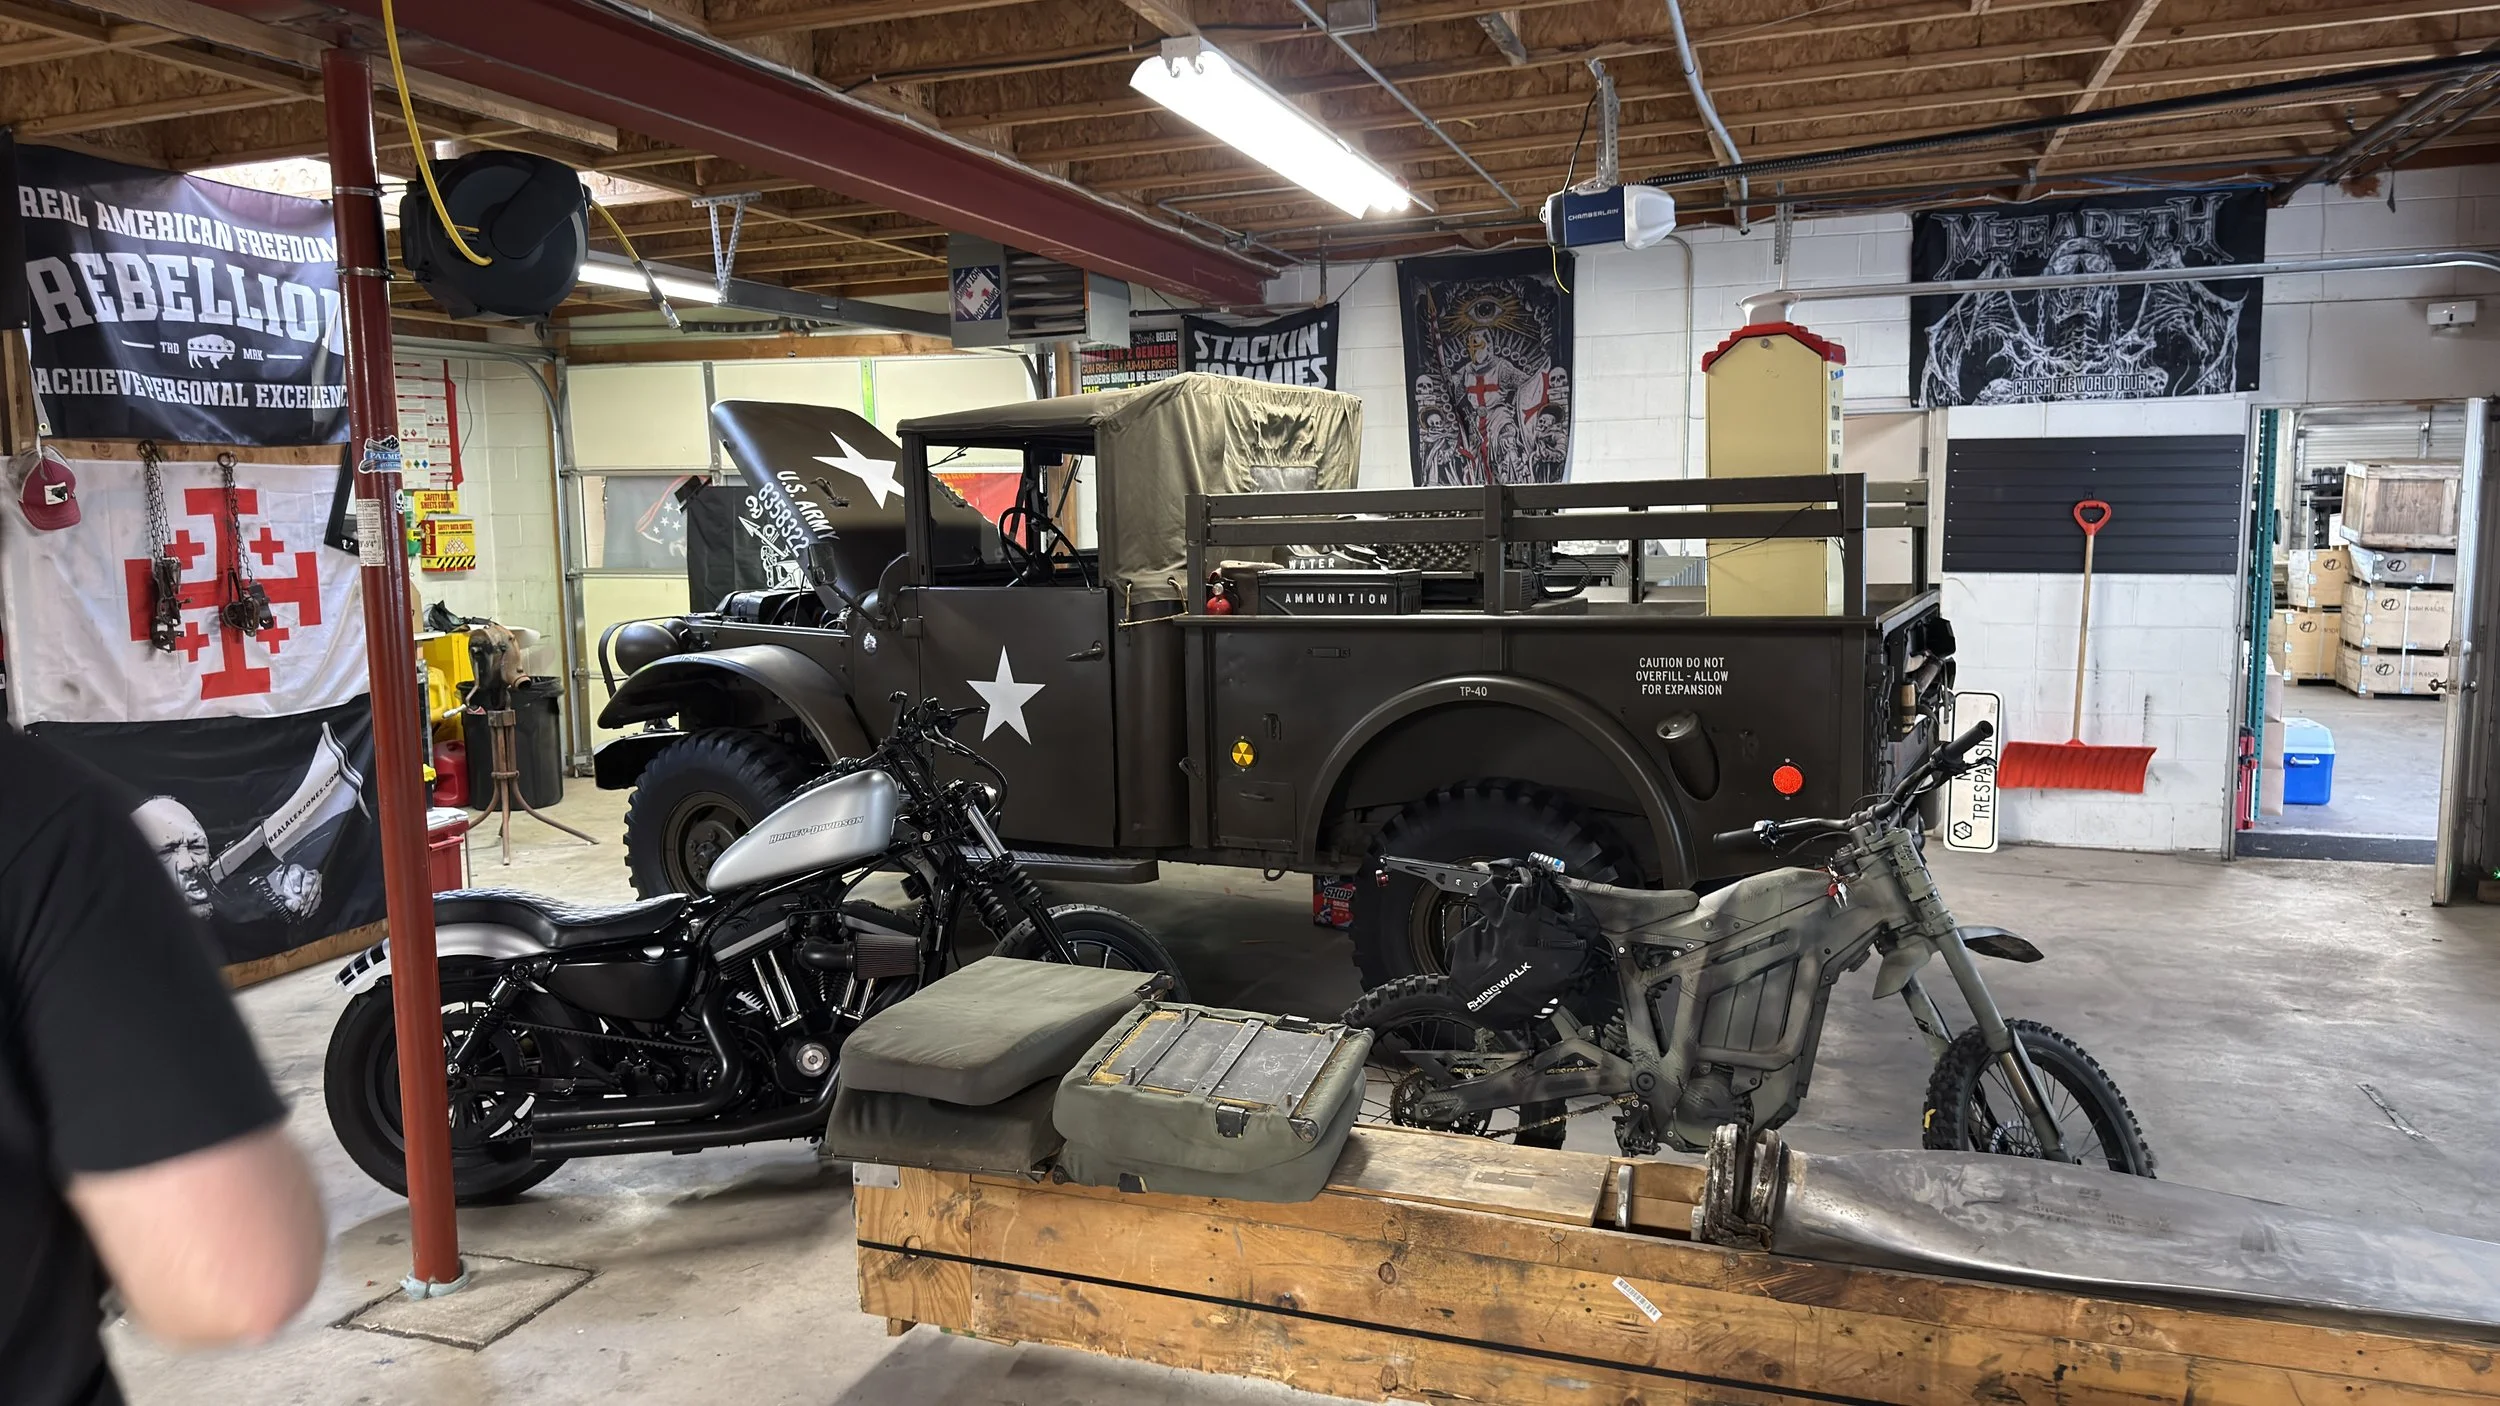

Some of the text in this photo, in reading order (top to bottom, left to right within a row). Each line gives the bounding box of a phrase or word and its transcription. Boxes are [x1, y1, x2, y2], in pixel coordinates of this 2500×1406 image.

[18, 186, 88, 227] REAL
[94, 201, 233, 251] AMERICAN
[1568, 208, 1619, 221] CHAMBERLAIN
[1930, 192, 2235, 281] MEGADETH
[1156, 331, 1177, 342] BELIEVE
[1194, 321, 1328, 364] STACKIN'
[1136, 344, 1177, 358] GENDERS
[1082, 359, 1177, 374] GUN RIGHTS HUMAN RIGHTS
[1082, 374, 1110, 385] BORDERS
[1111, 371, 1135, 383] SHOULD
[1136, 371, 1146, 381] BE
[2014, 374, 2146, 395] CRUSH THE WORLD TOUR
[36, 368, 349, 409] ACHIEVE PERSONAL EXCELLENC
[777, 471, 840, 540] U.S. ARMY
[758, 482, 809, 558] 8358322
[1288, 558, 1335, 569] WATER
[1285, 593, 1387, 605] AMMUNITION
[1640, 657, 1724, 668] CAUTION DO NOT
[1636, 671, 1684, 681] OVERFILL
[1694, 671, 1728, 681] ALLOW
[1460, 686, 1488, 696] TP-40
[1642, 684, 1722, 695] FOR EXPANSION
[267, 769, 339, 843] REALALEXJONES.COM
[769, 816, 864, 844] HARLEY-DAVIDSON
[1324, 886, 1354, 900] SHOP
[1466, 961, 1532, 1010] RHINOWALK
